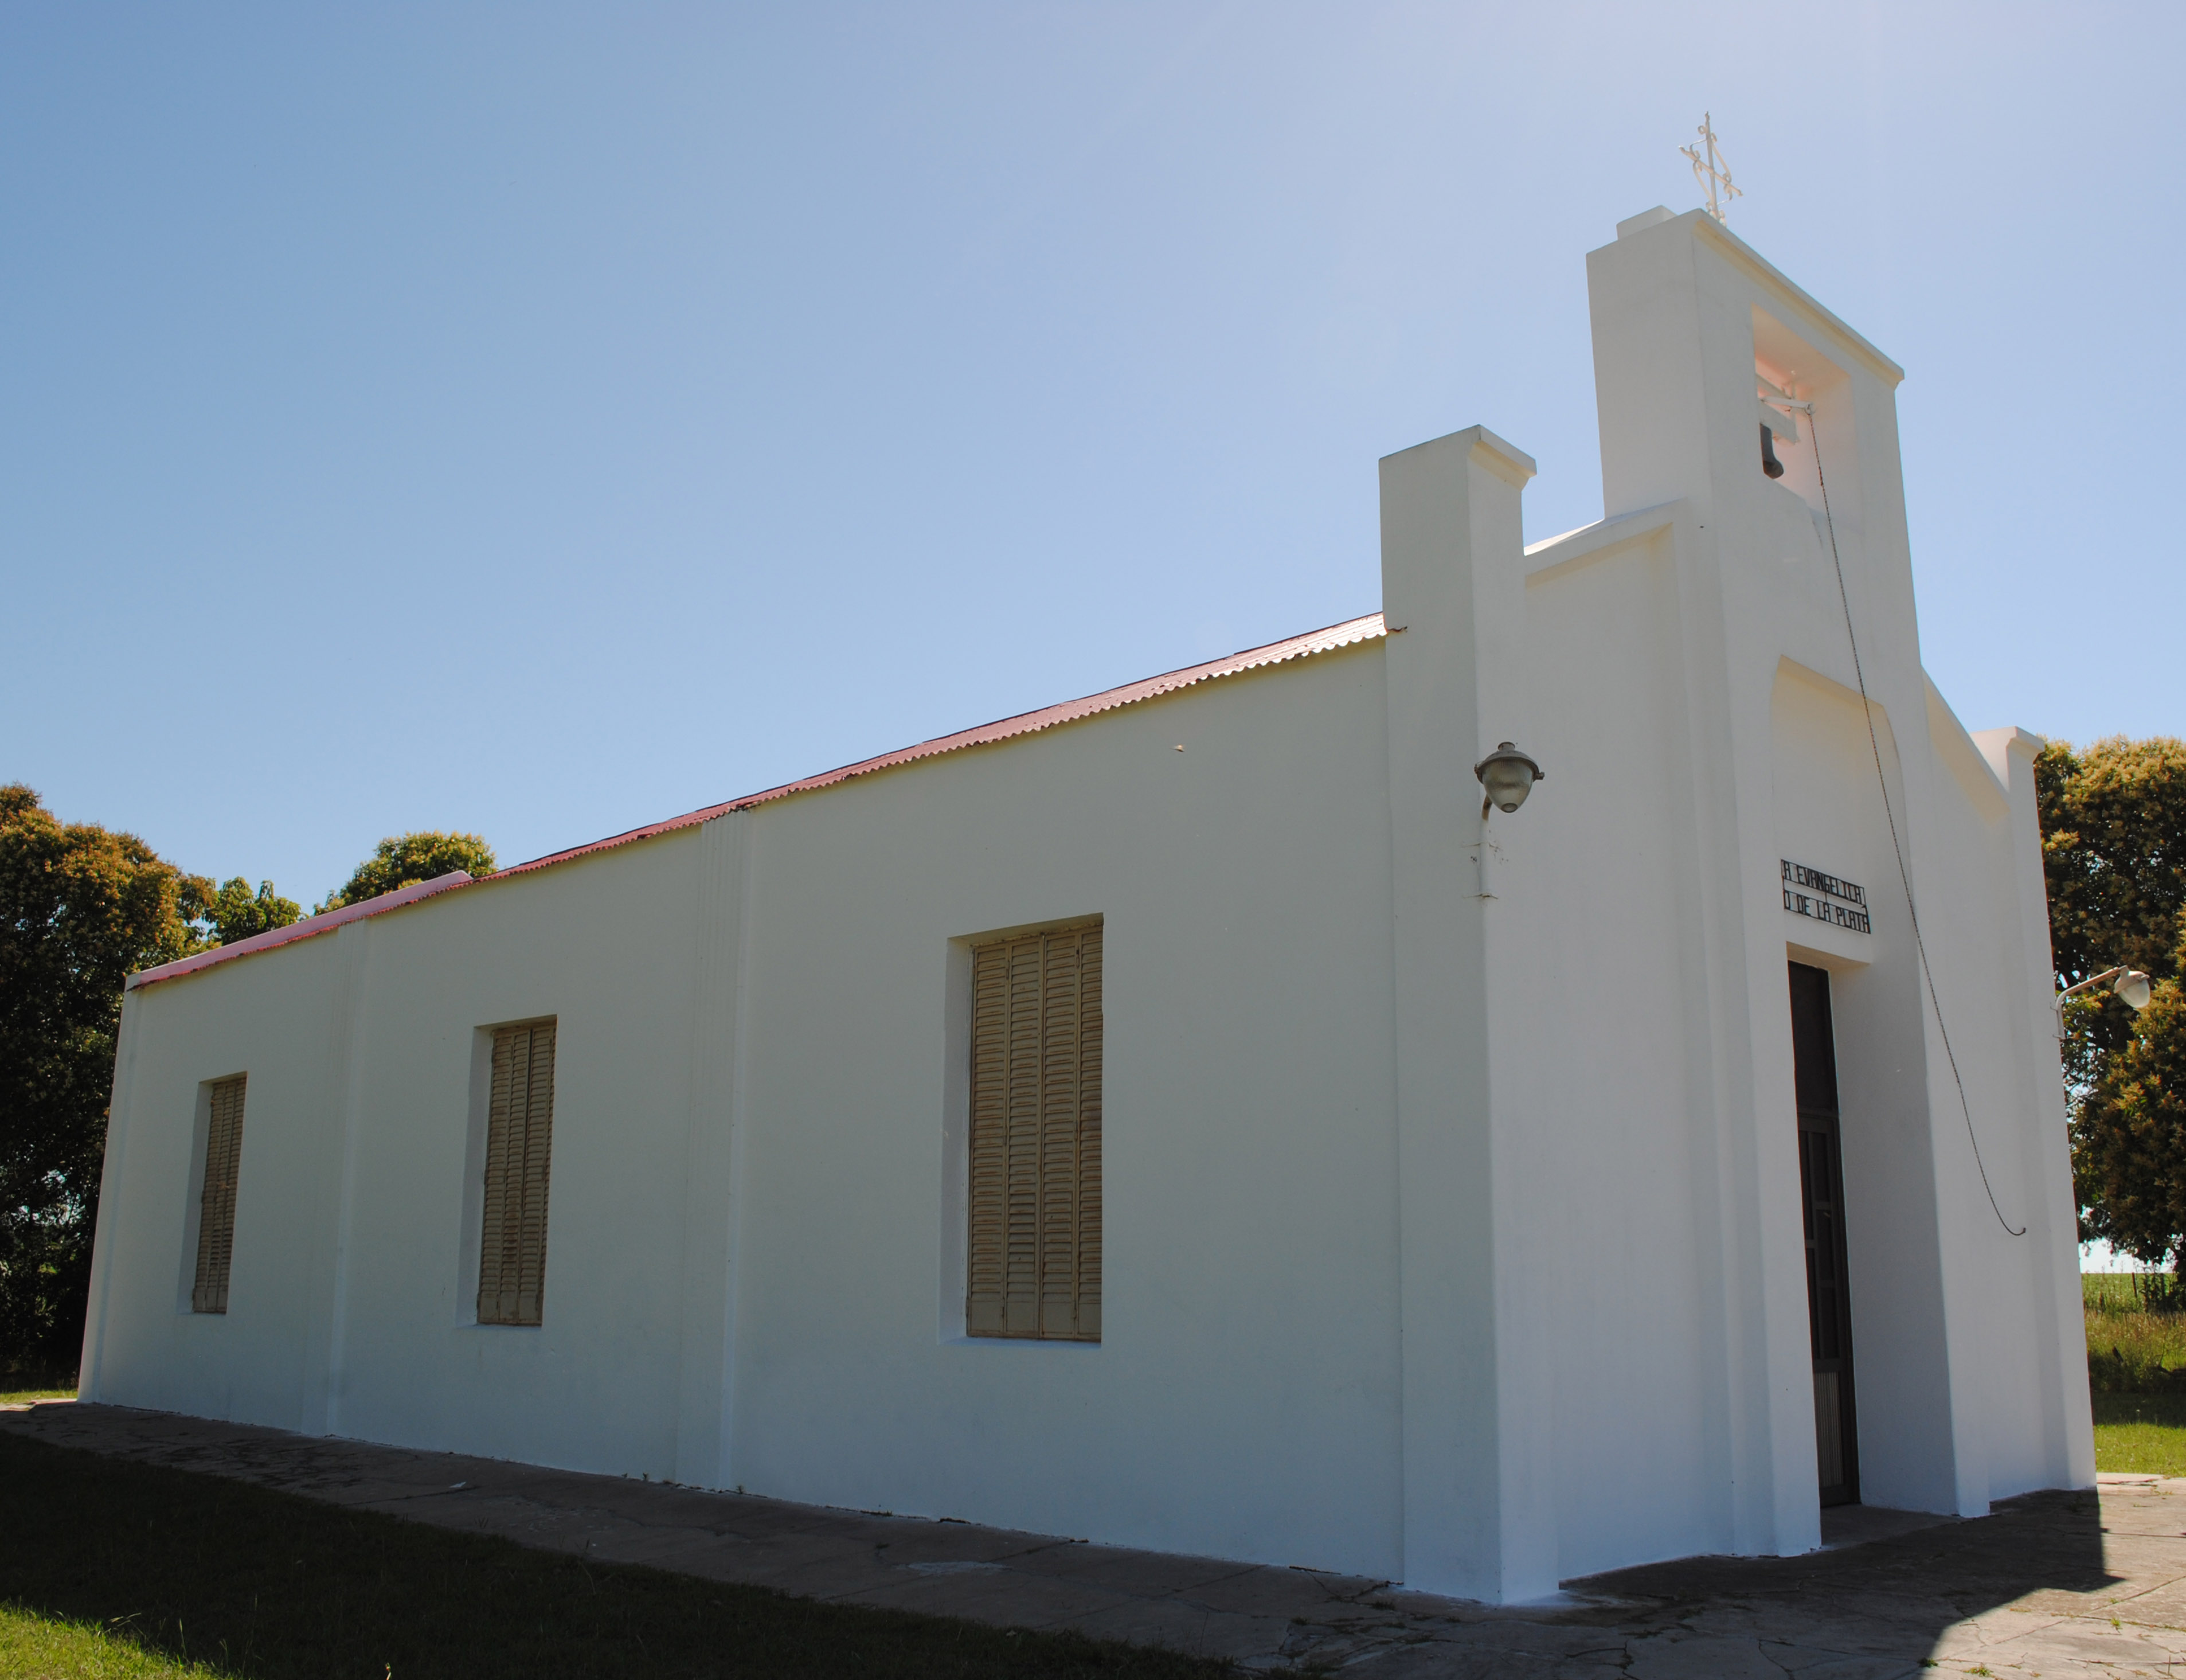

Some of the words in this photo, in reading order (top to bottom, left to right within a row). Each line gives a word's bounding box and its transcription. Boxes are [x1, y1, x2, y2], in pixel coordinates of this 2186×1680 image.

[1796, 894, 1811, 916] DE
[1817, 900, 1831, 923] LA
[1836, 905, 1871, 934] PLATA
